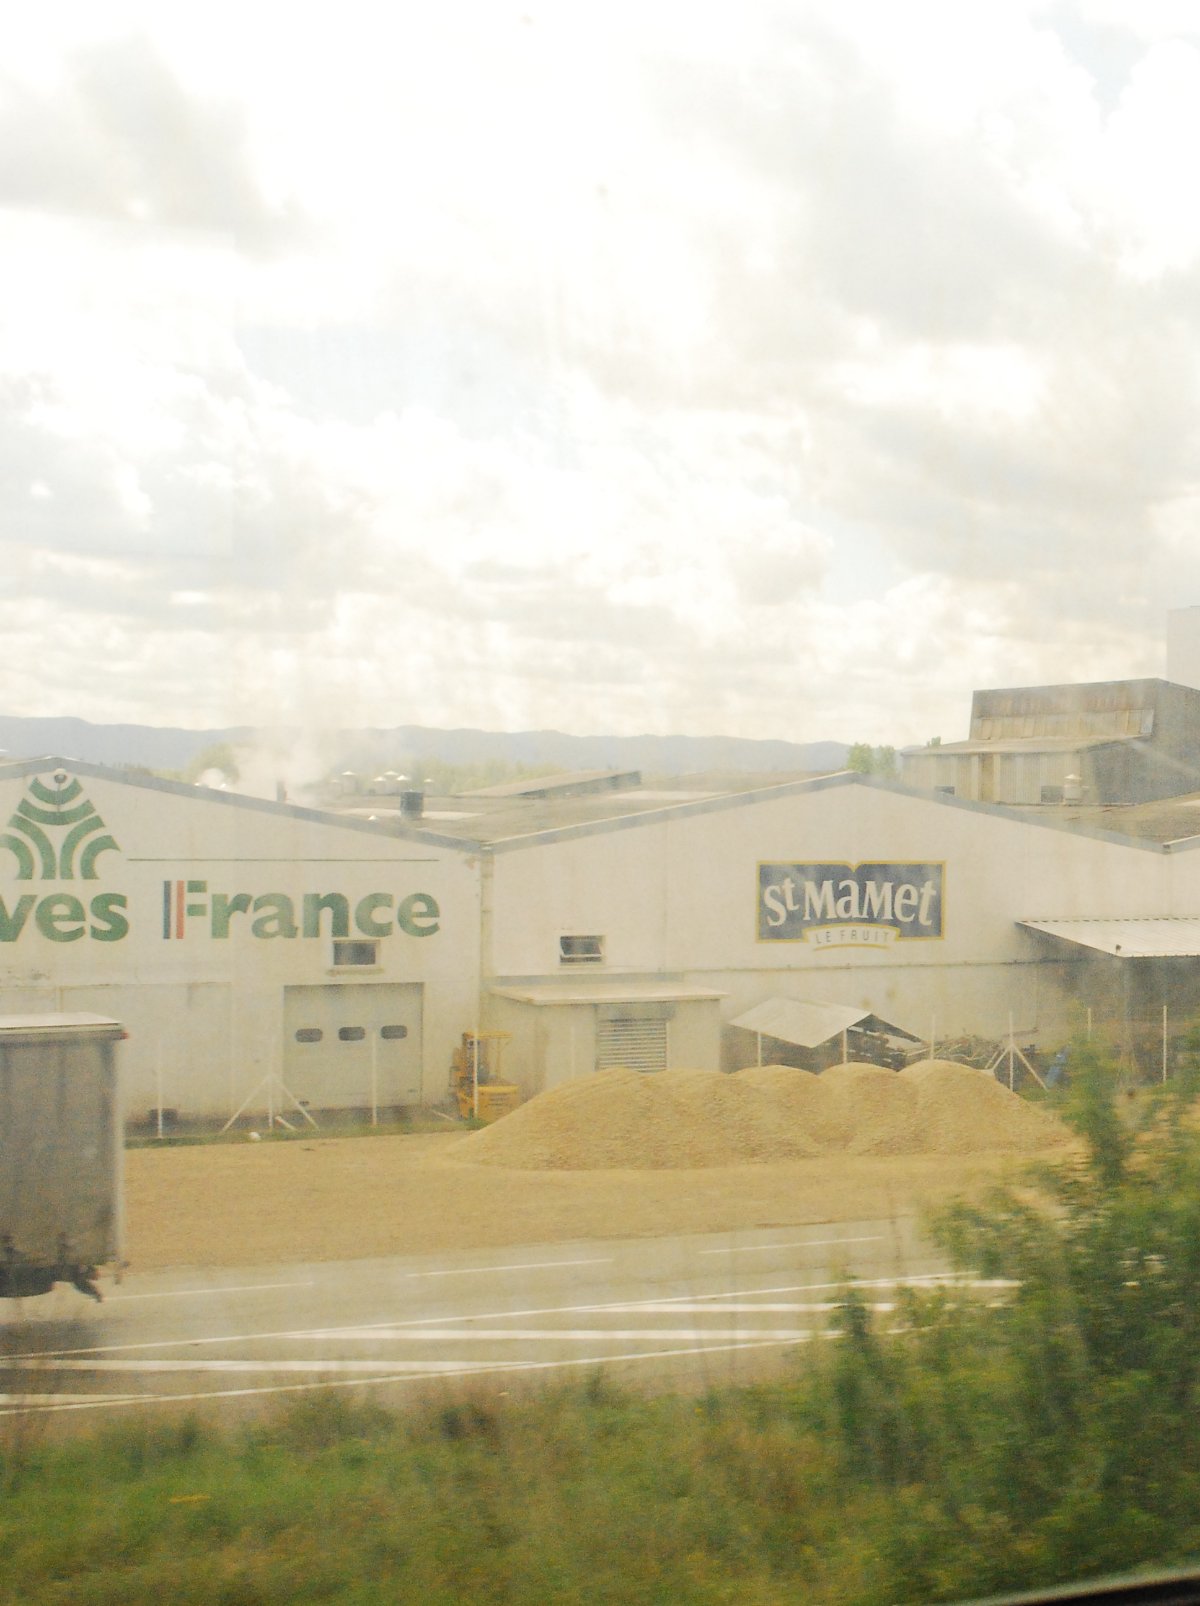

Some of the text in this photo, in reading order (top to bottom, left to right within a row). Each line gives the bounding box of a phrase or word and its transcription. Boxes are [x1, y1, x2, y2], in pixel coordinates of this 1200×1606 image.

[0, 880, 441, 942] ves France
[763, 877, 800, 926] St
[815, 929, 890, 944] LE FRUIT
